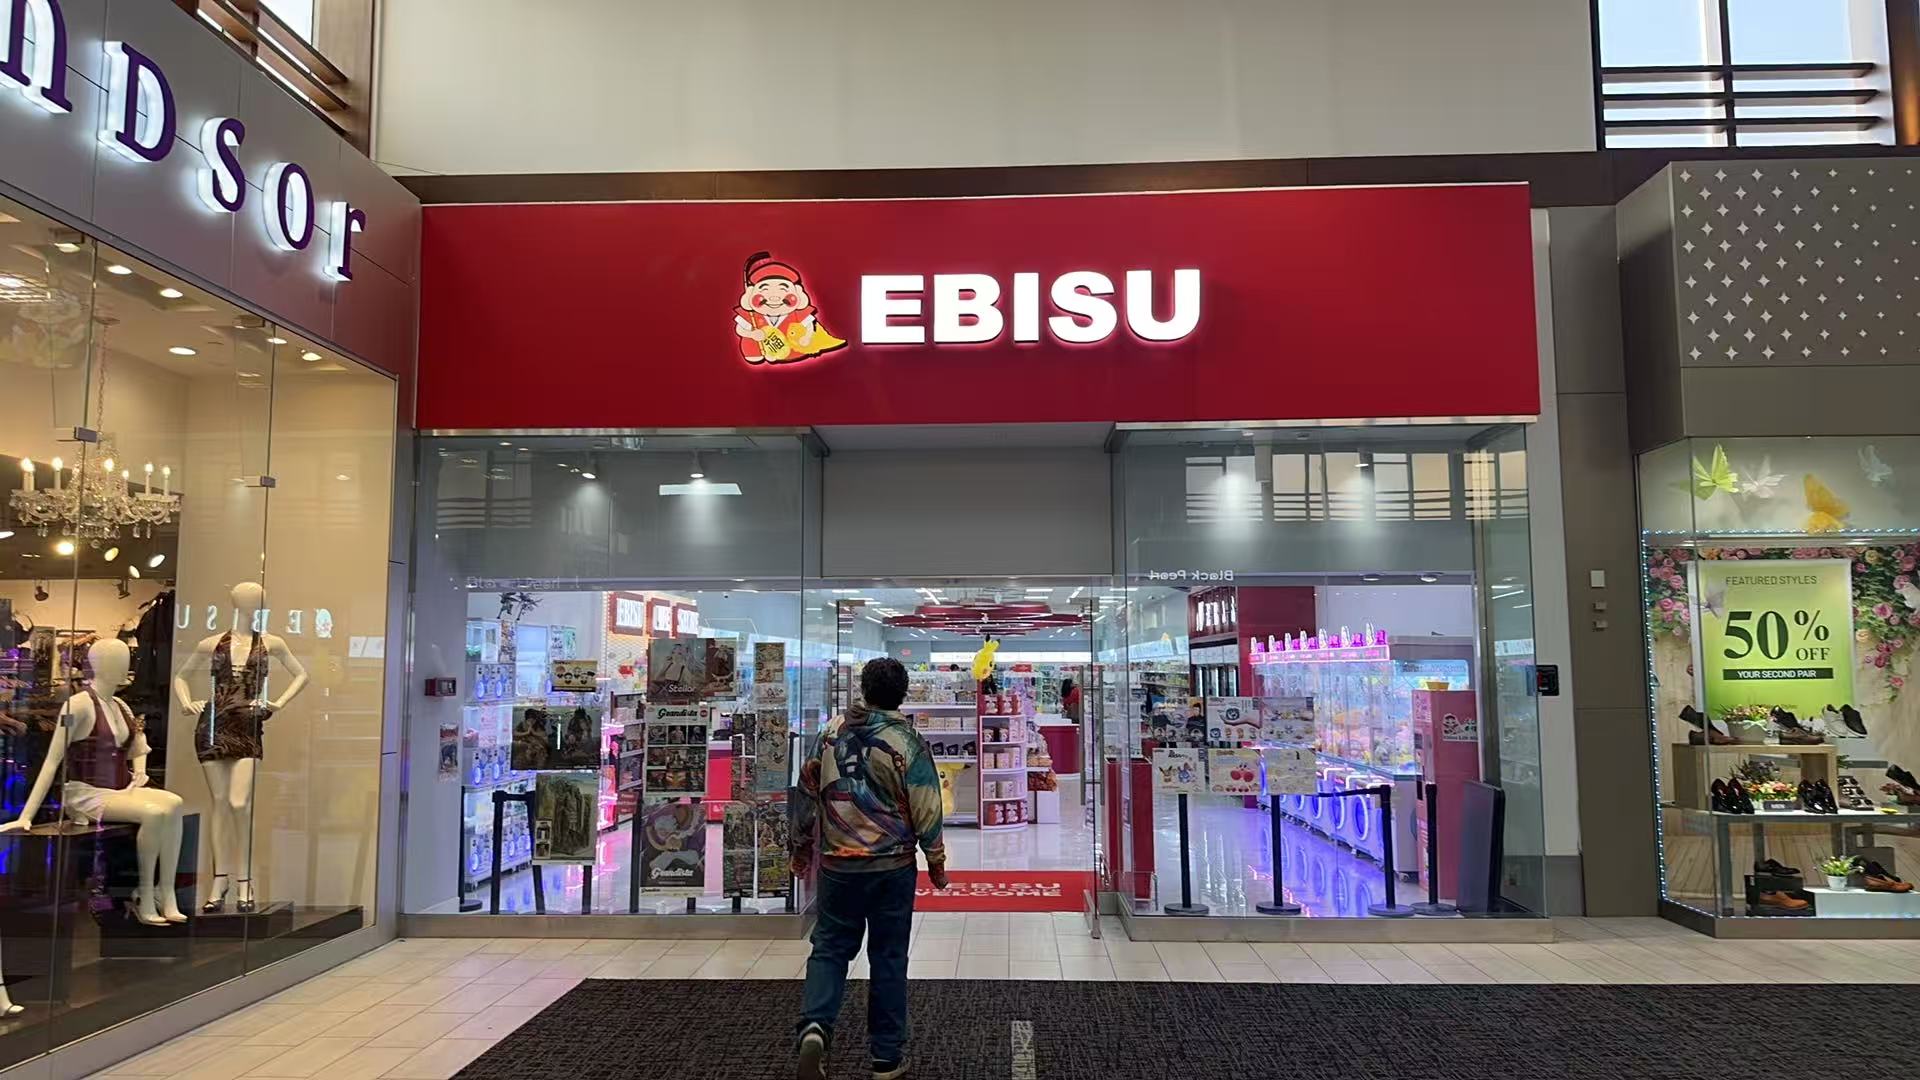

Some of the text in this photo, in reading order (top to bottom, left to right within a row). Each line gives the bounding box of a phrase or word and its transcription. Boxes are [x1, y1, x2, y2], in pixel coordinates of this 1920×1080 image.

[860, 268, 1201, 345] EBISU
[1726, 575, 1817, 585] FEATURED STYLES
[1723, 610, 1830, 660] 50%
[1796, 647, 1830, 661] OFF
[1737, 670, 1817, 679] YOUR SECOND PAIR
